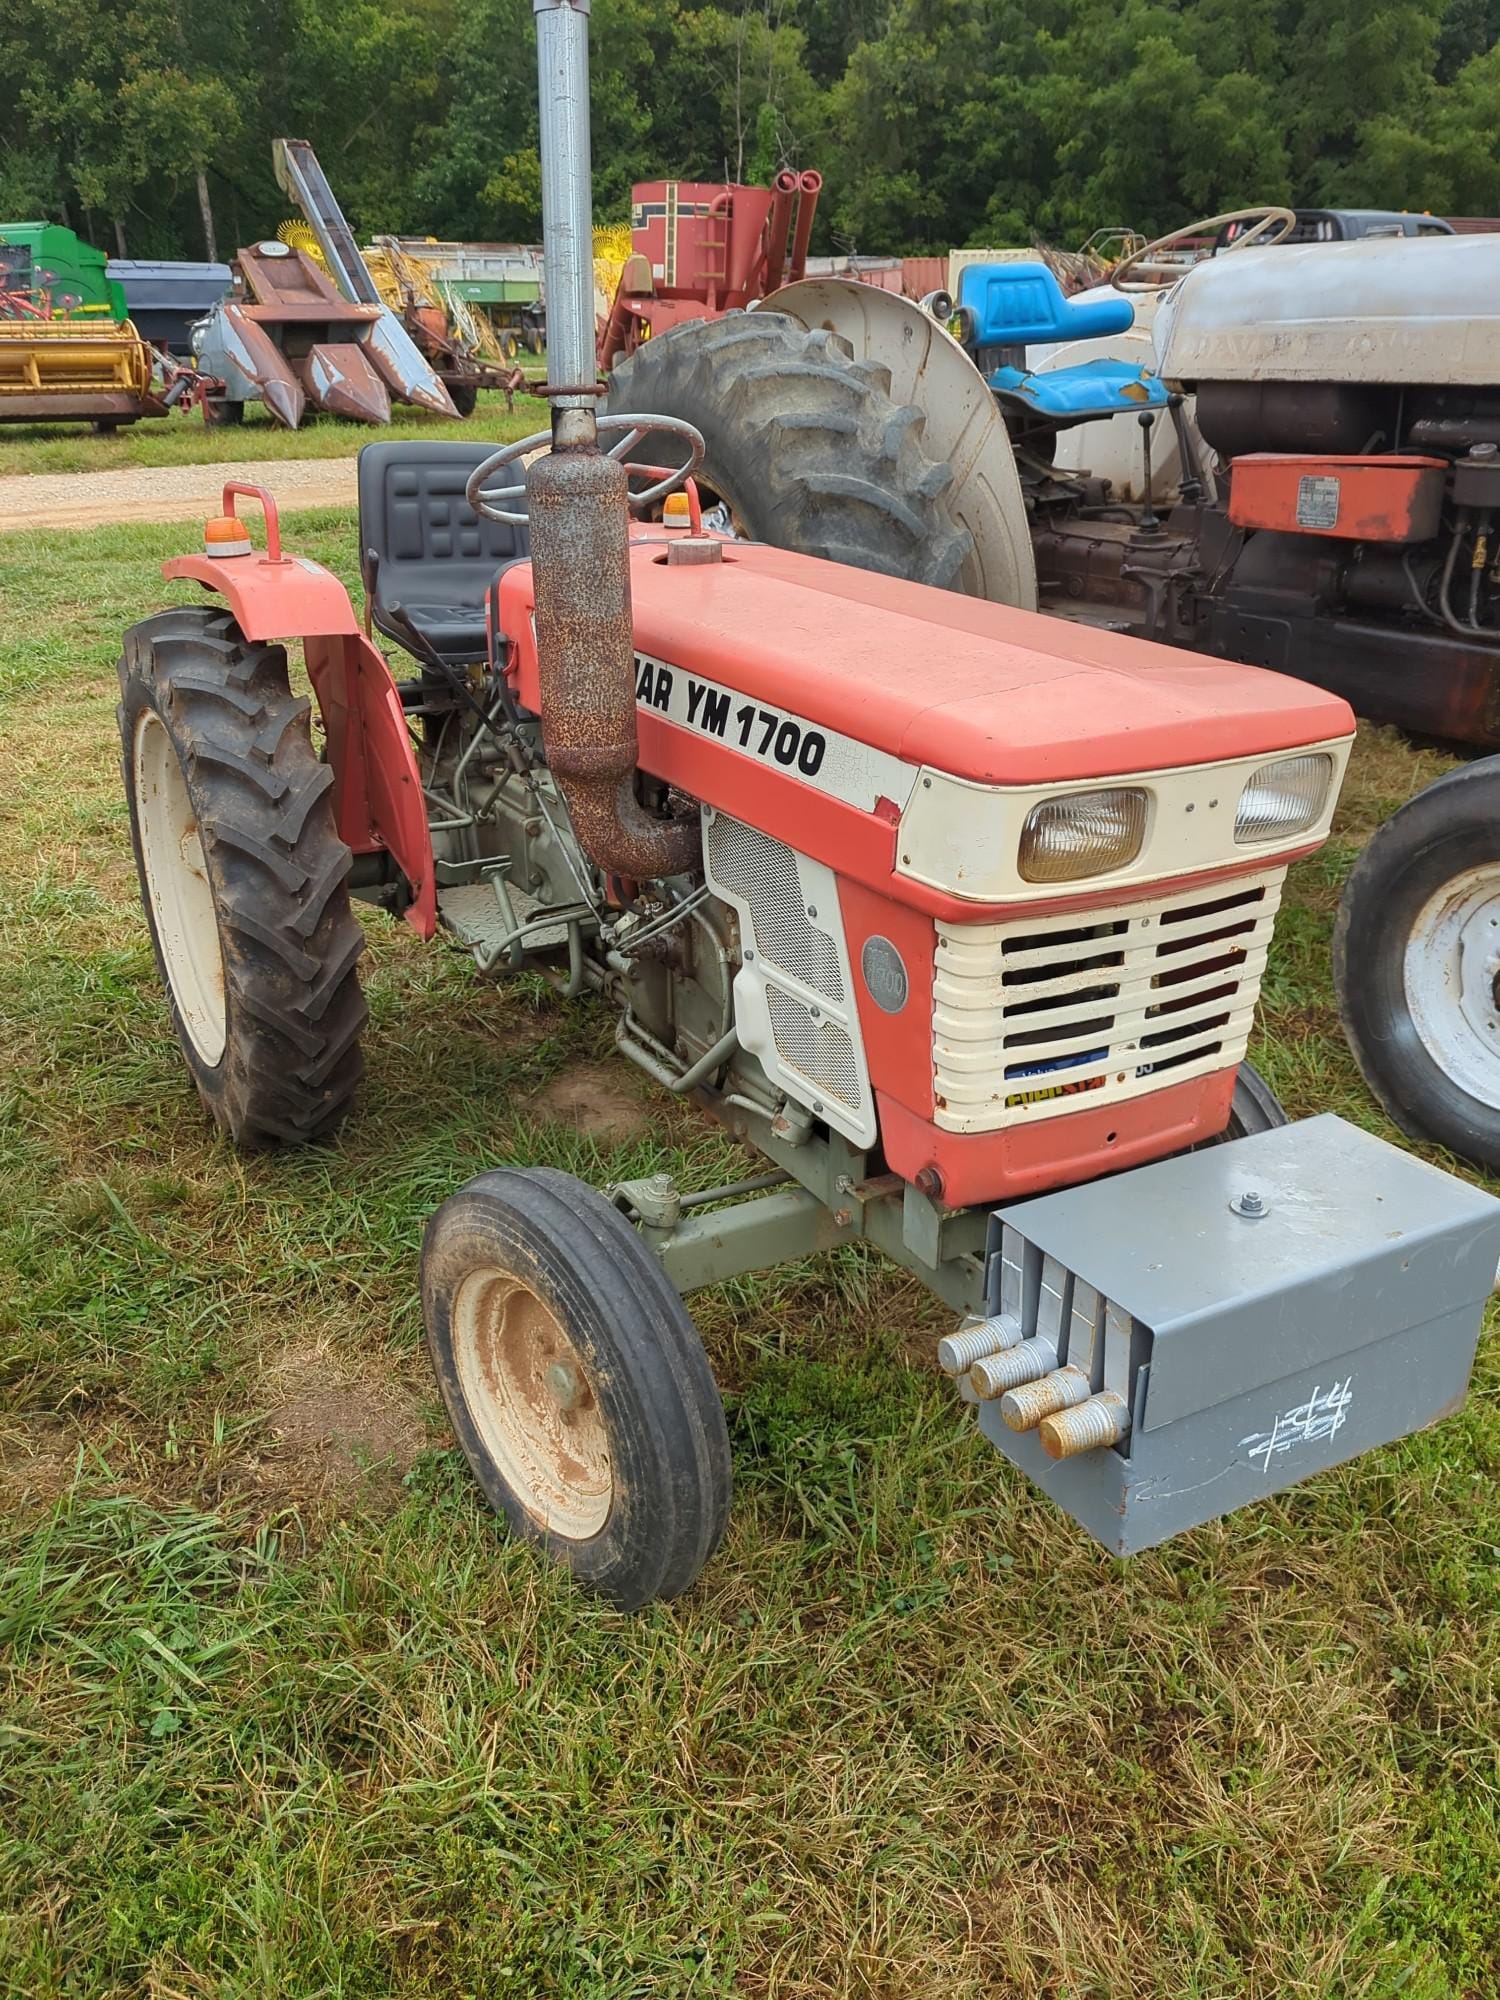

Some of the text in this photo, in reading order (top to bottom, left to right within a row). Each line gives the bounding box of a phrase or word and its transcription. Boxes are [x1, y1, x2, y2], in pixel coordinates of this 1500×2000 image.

[634, 657, 826, 777] AR YM 1700
